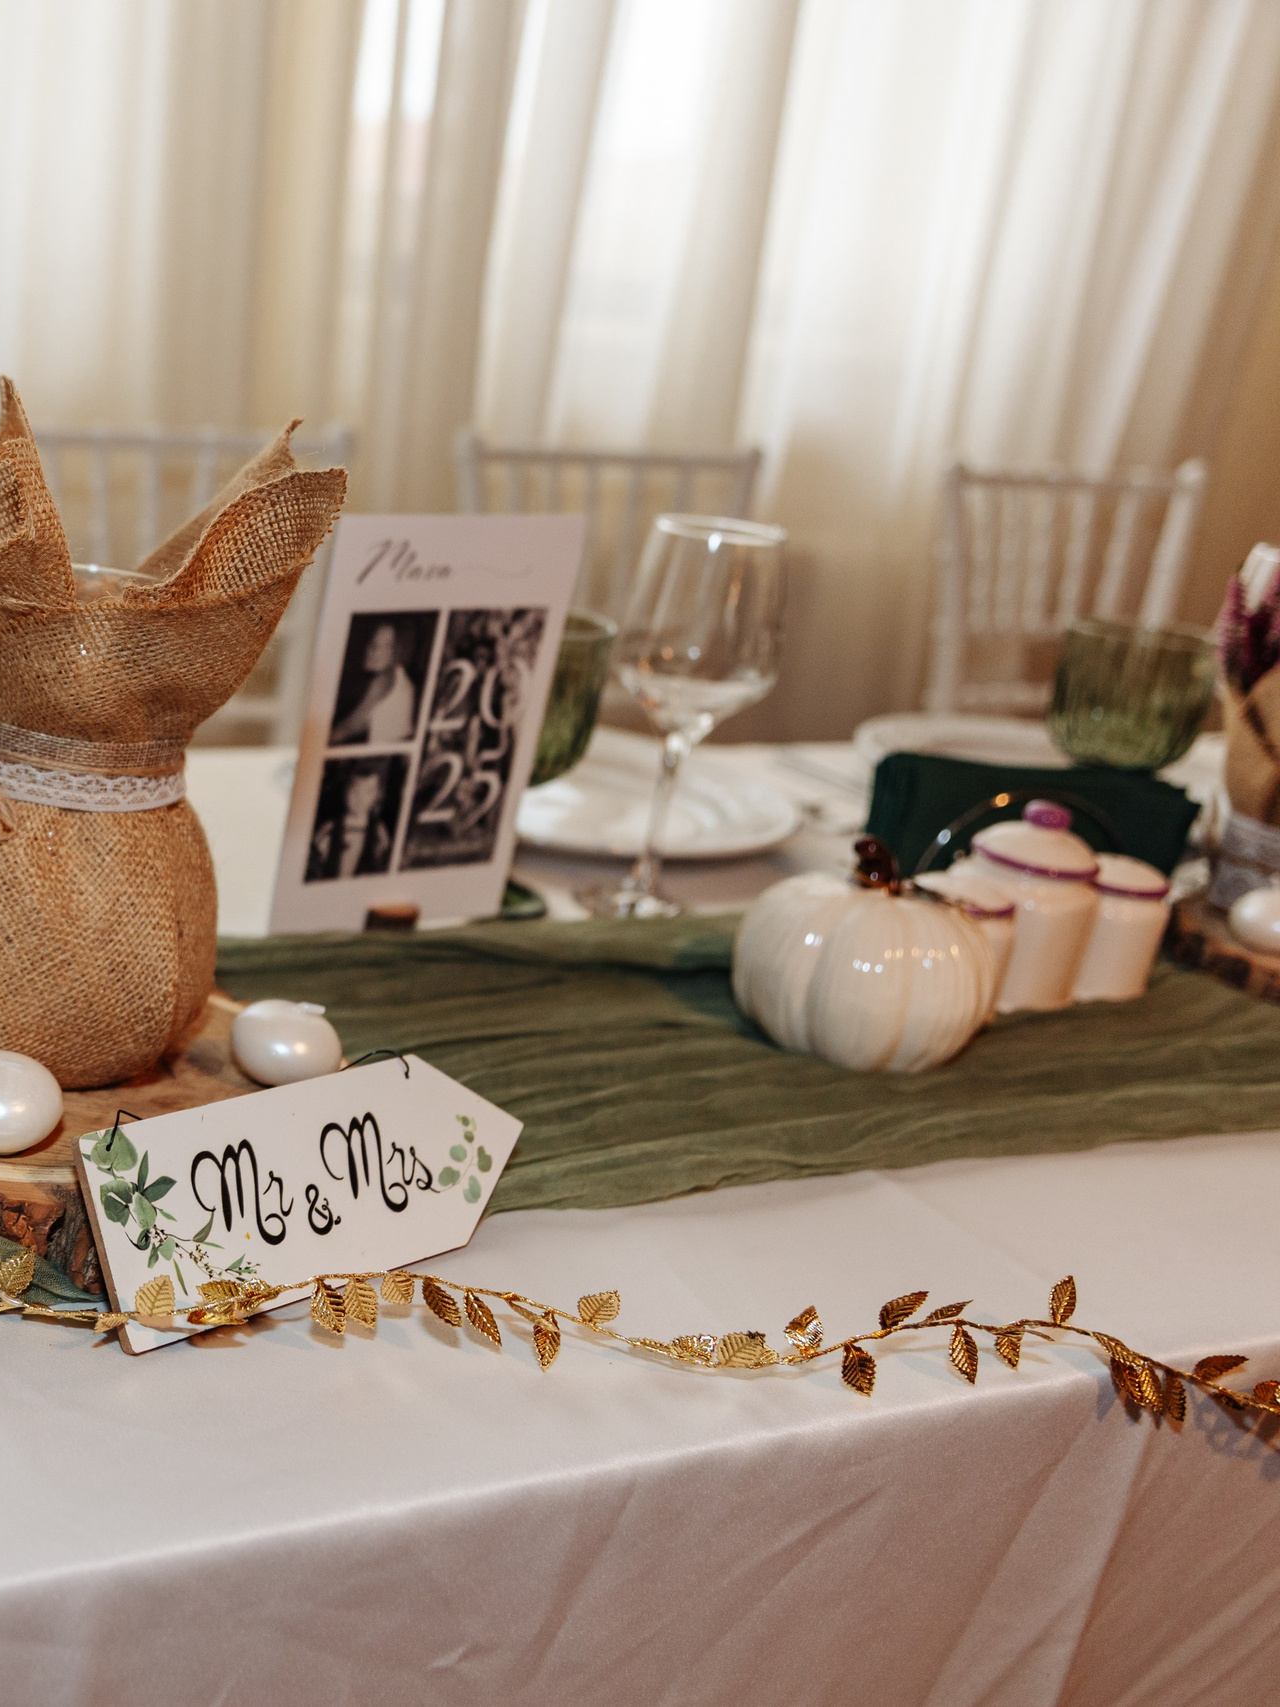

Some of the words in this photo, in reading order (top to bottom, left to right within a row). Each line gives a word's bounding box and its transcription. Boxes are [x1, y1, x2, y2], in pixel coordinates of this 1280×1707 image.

[190, 1138, 295, 1246] Mr
[305, 1183, 342, 1236] &
[320, 1111, 441, 1213] Mrs
